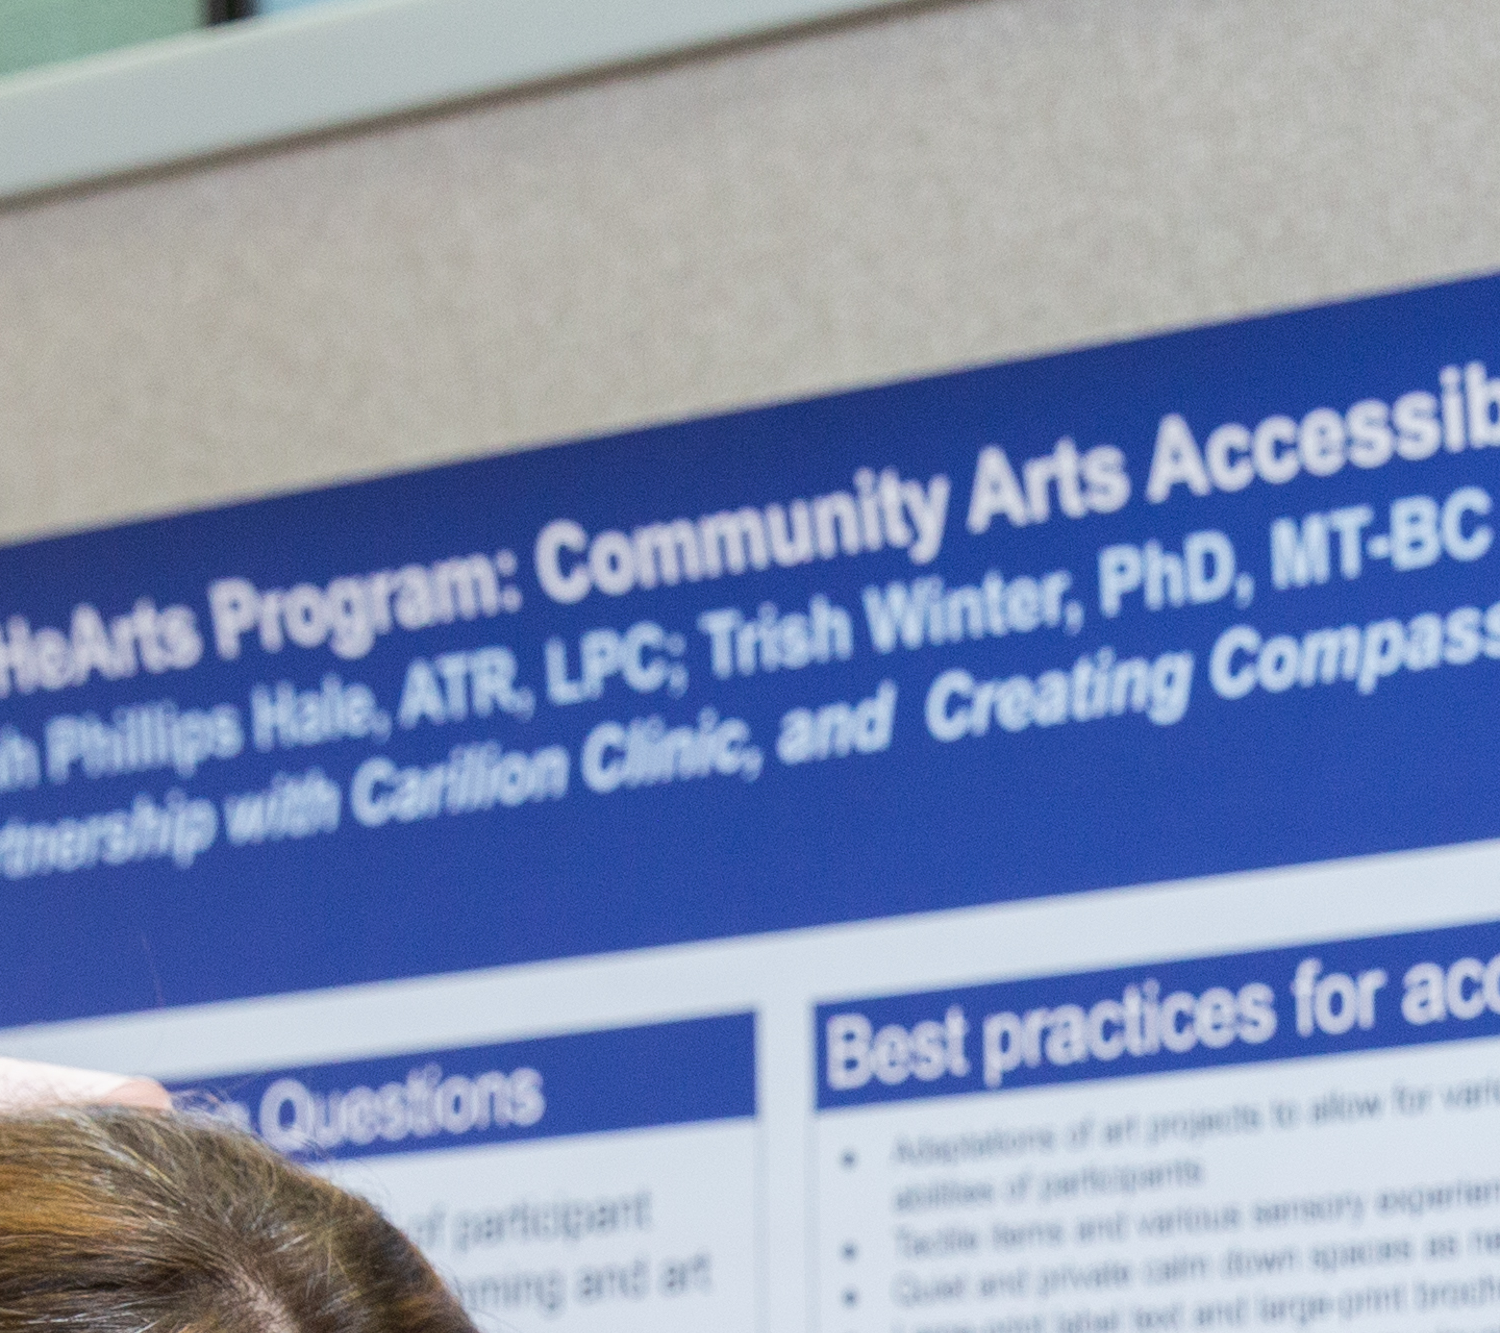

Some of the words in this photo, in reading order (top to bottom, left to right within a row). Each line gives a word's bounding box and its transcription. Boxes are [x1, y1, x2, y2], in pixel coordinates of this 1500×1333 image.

[209, 548, 523, 658] Program:
[535, 466, 950, 602] Community
[968, 435, 1130, 535] Arts
[46, 701, 243, 784] Phillips
[251, 673, 390, 750] Hale,
[398, 646, 535, 727] ATR,
[544, 621, 688, 704] LPC;
[699, 594, 852, 679] Trish
[862, 568, 1084, 654] Winter,
[1099, 530, 1254, 617] PhD,
[1269, 486, 1494, 589] MT-BC
[224, 767, 342, 845] with
[350, 741, 569, 828] Carilion
[581, 707, 763, 793] Clinic,
[776, 680, 898, 767] and
[925, 647, 1194, 743] Creating
[825, 1003, 970, 1092] Best
[982, 977, 1278, 1089] practices
[1294, 957, 1388, 1037] for
[260, 1063, 547, 1152] Questions
[452, 1190, 652, 1254] participant
[575, 1258, 650, 1304] and
